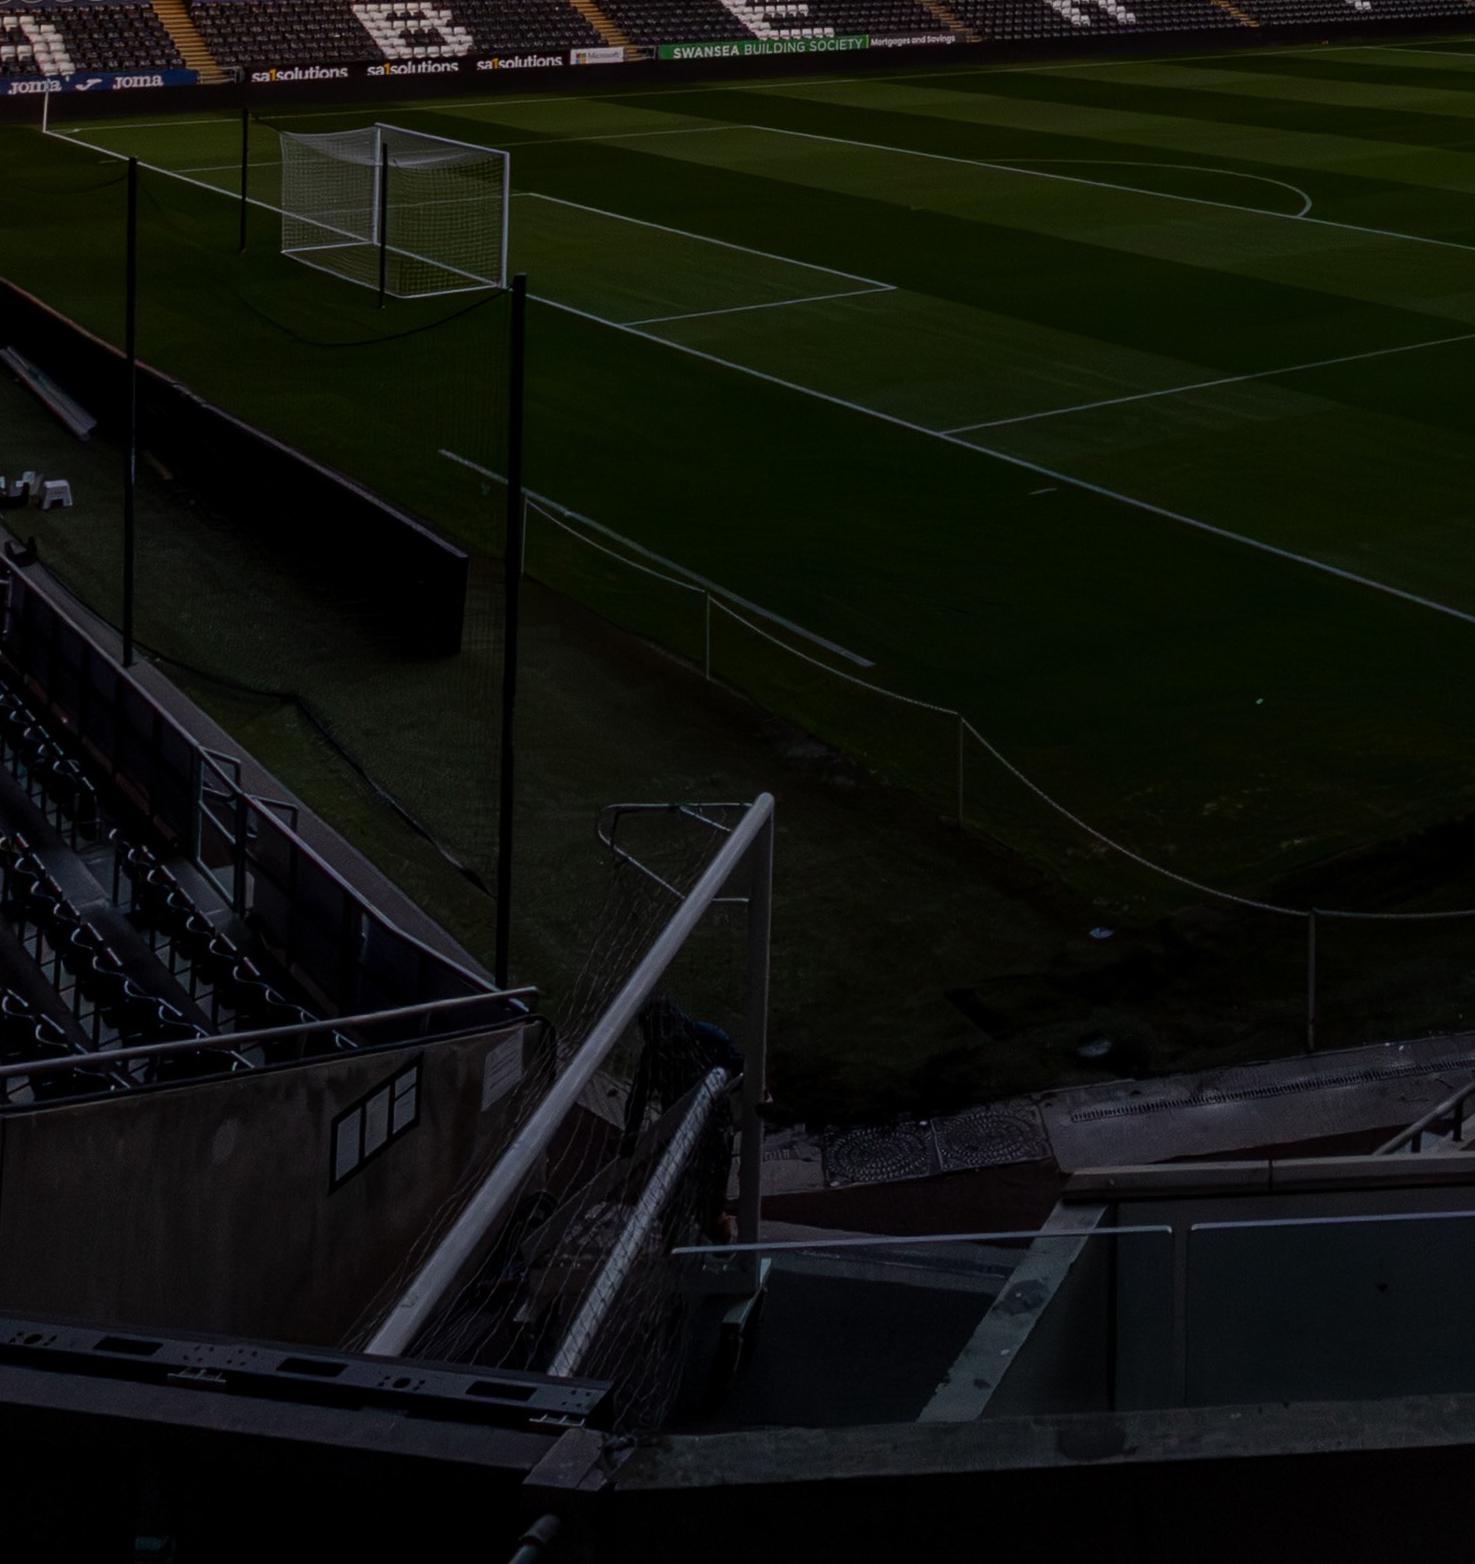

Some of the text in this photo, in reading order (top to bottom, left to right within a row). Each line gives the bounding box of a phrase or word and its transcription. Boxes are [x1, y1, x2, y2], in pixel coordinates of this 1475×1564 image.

[674, 38, 863, 59] SWANSEA BUILDING SOCIETY
[870, 34, 956, 47] Mortgages and Savings
[367, 61, 459, 77] sa1solutions
[477, 55, 563, 71] sa1solutions
[251, 66, 350, 84] sa1solutions
